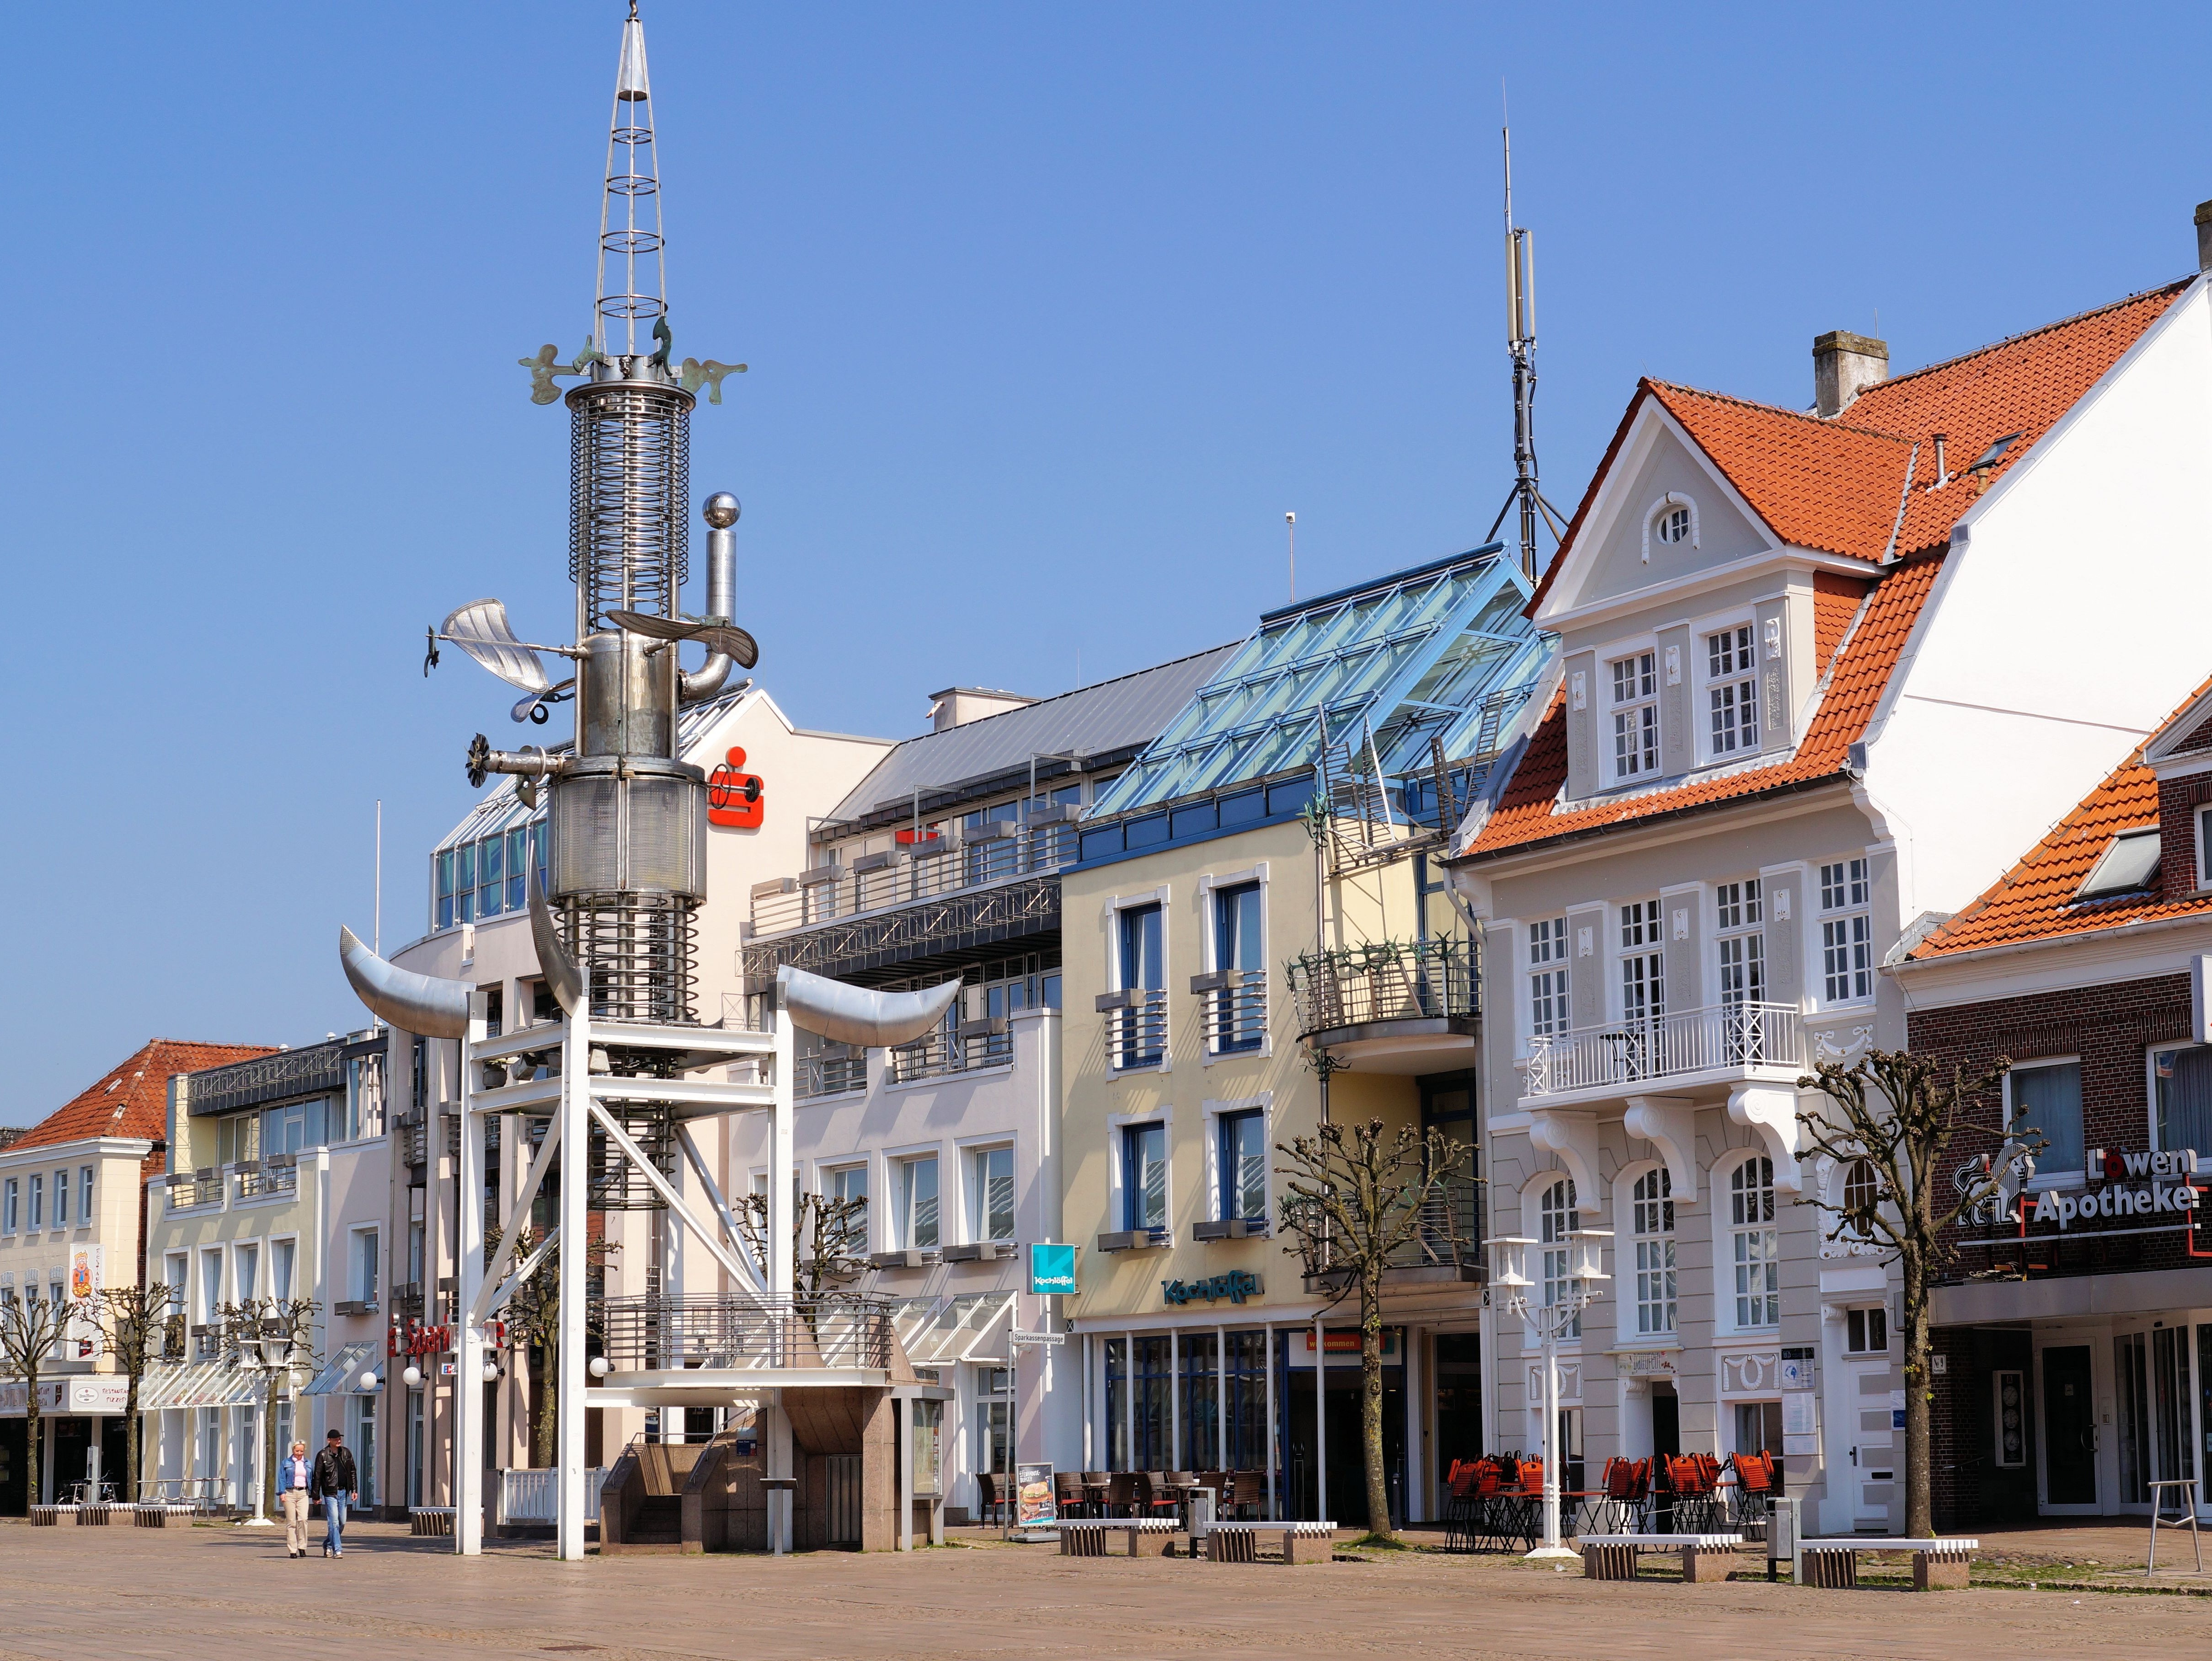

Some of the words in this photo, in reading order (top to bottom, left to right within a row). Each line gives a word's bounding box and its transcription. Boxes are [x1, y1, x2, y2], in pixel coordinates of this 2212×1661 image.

[2088, 1147, 2197, 1179] Löwen
[2033, 1182, 2200, 1230] Apotheke
[1034, 1275, 1073, 1286] Kochlöffel
[1161, 1270, 1261, 1305] Kochlöffel
[1015, 1334, 1063, 1344] Sparkassenpassage
